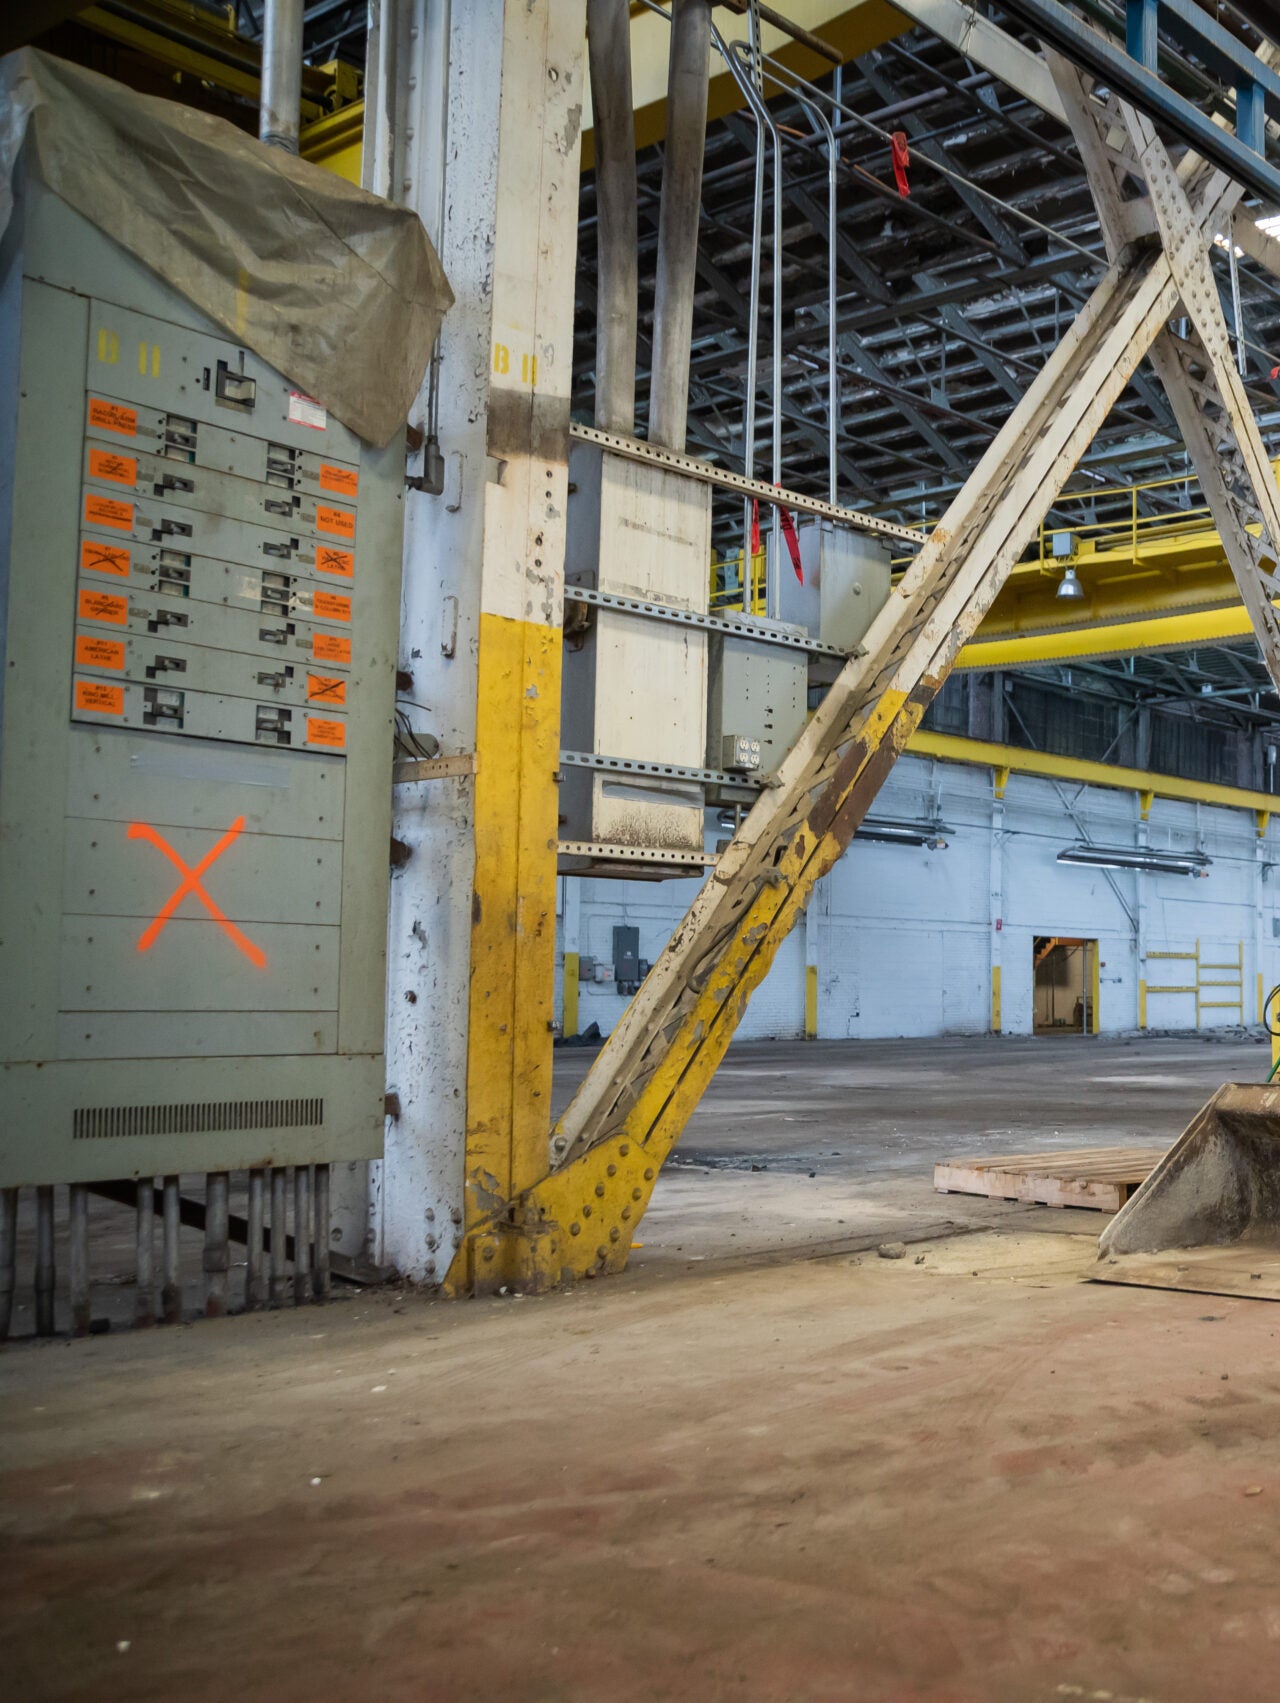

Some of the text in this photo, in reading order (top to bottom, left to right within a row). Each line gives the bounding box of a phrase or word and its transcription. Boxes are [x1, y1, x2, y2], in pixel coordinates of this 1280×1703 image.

[97, 327, 119, 365] B
[494, 342, 510, 375] B
[320, 515, 354, 529] NOT USED
